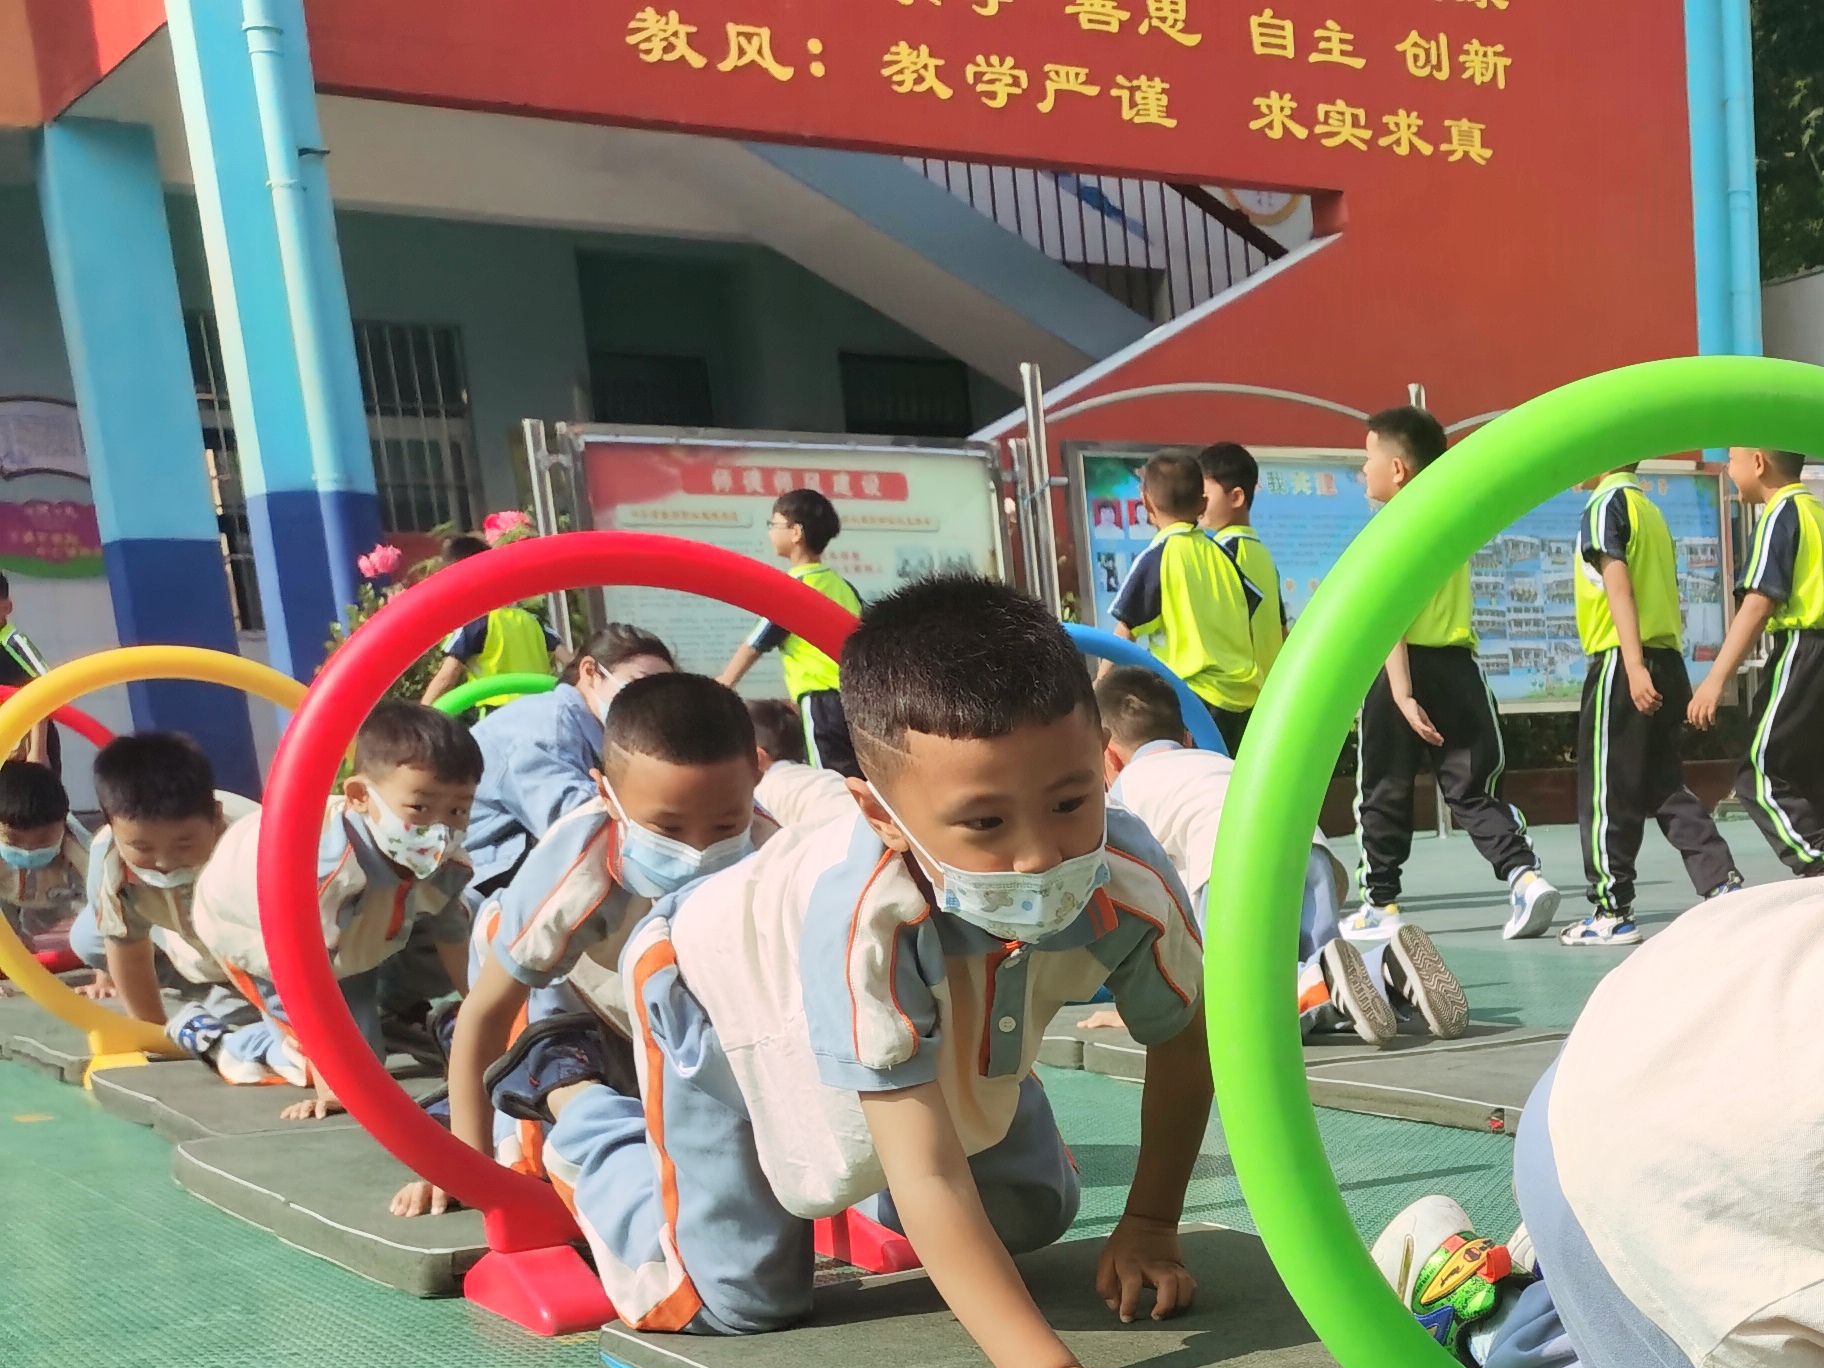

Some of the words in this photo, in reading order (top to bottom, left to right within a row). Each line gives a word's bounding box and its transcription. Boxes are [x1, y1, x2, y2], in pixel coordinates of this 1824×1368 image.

[1250, 8, 1366, 69] 自主
[1395, 30, 1512, 89] 创新
[880, 41, 1178, 128] 教学严谨
[1249, 90, 1493, 165] 求实求真
